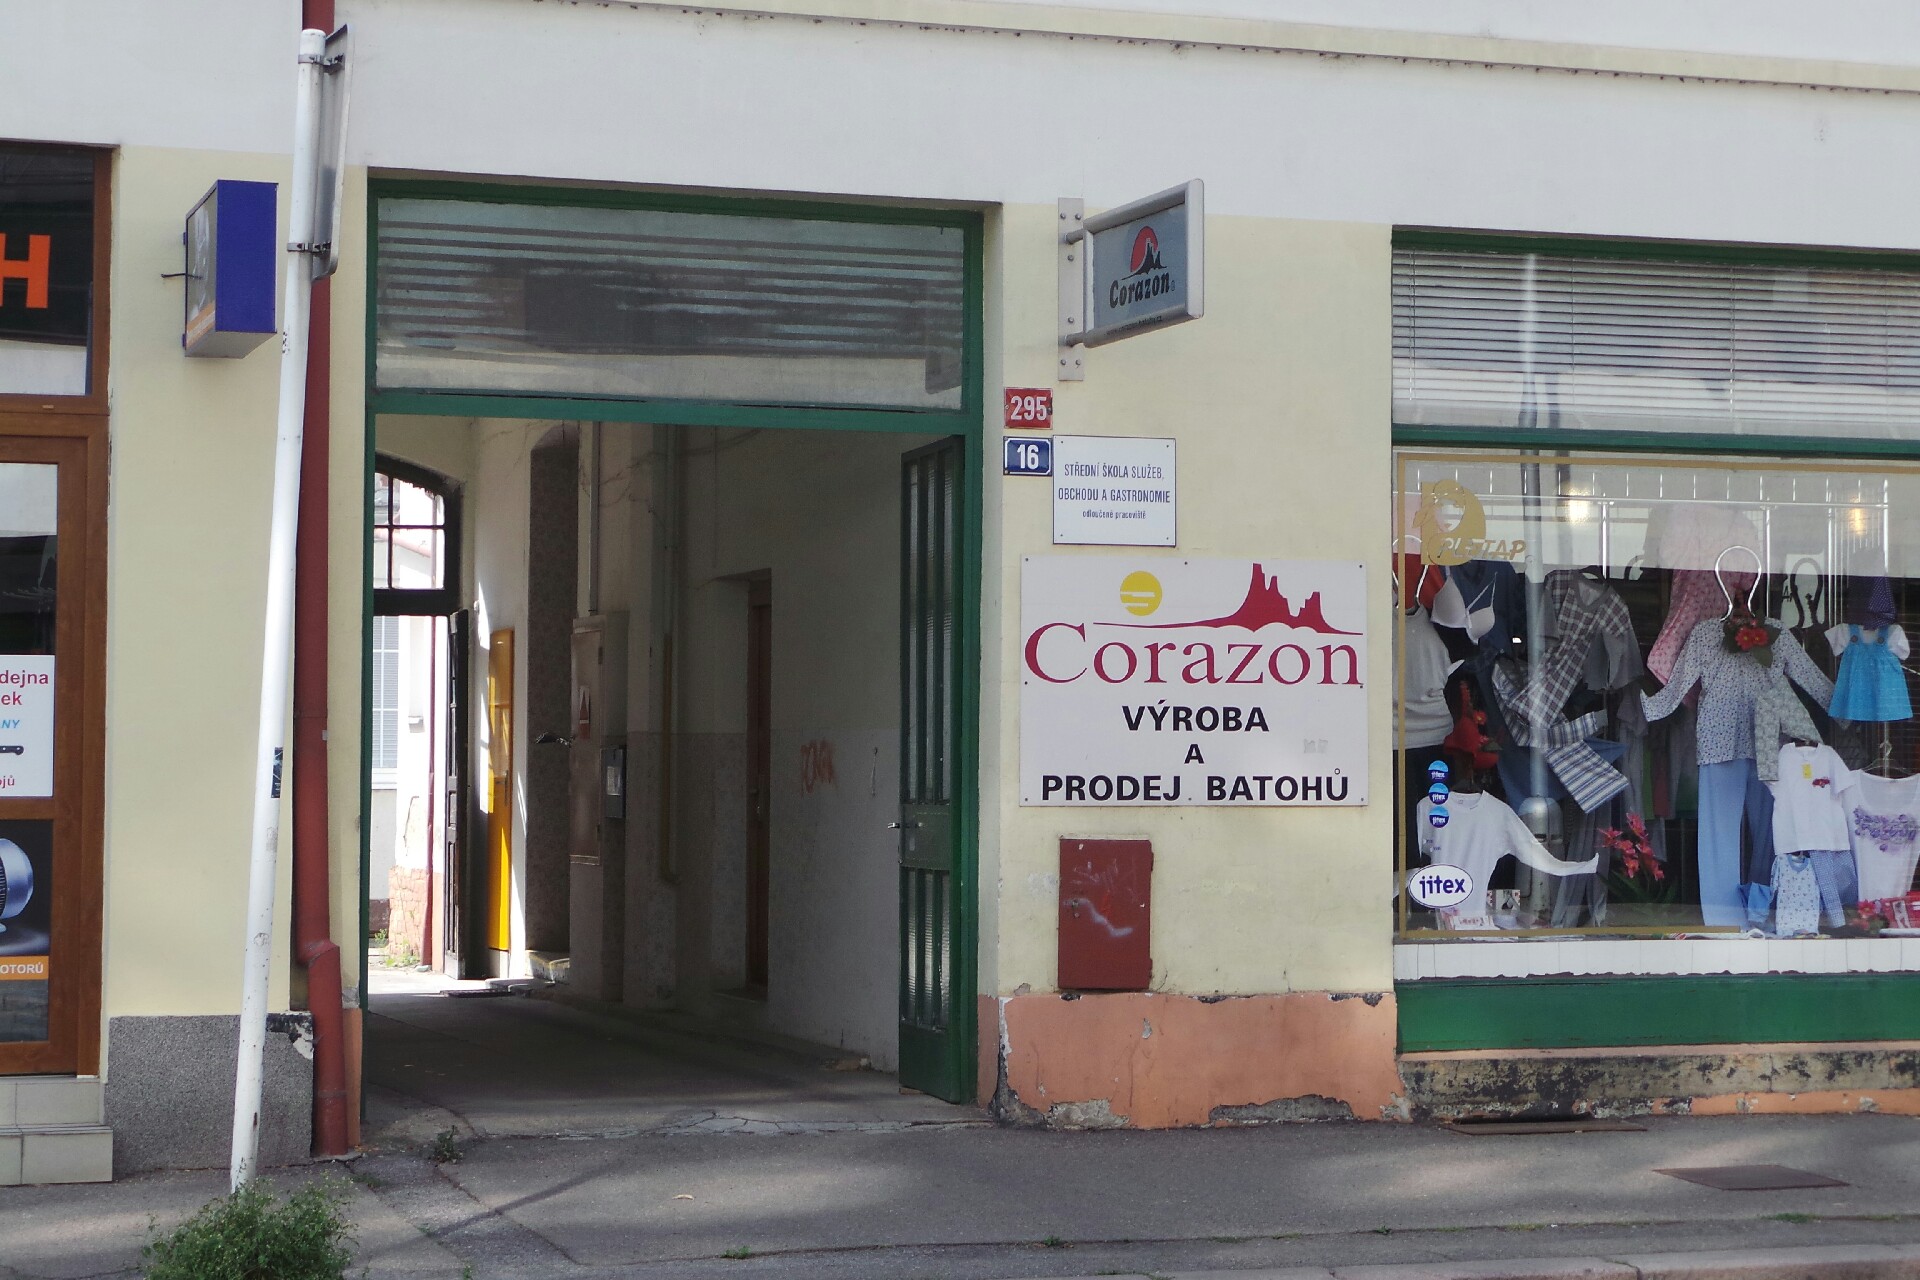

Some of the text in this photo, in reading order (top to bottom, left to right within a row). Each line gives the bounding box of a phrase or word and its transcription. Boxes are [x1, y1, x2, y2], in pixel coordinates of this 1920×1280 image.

[1109, 271, 1170, 309] Corazon
[1010, 395, 1047, 421] 295
[1016, 443, 1039, 470] 16
[1064, 461, 1100, 477] STŘEDNÍ
[1102, 463, 1129, 478] ŠKOLA
[1058, 487, 1171, 503] OBCHODU A GASTRONOMIE
[1024, 621, 1364, 686] Corazon
[1122, 699, 1270, 732] VÝROBA
[1184, 743, 1205, 764] A
[1042, 767, 1349, 802] PRODEJ BATOHŮ
[1419, 875, 1466, 899] jitex
